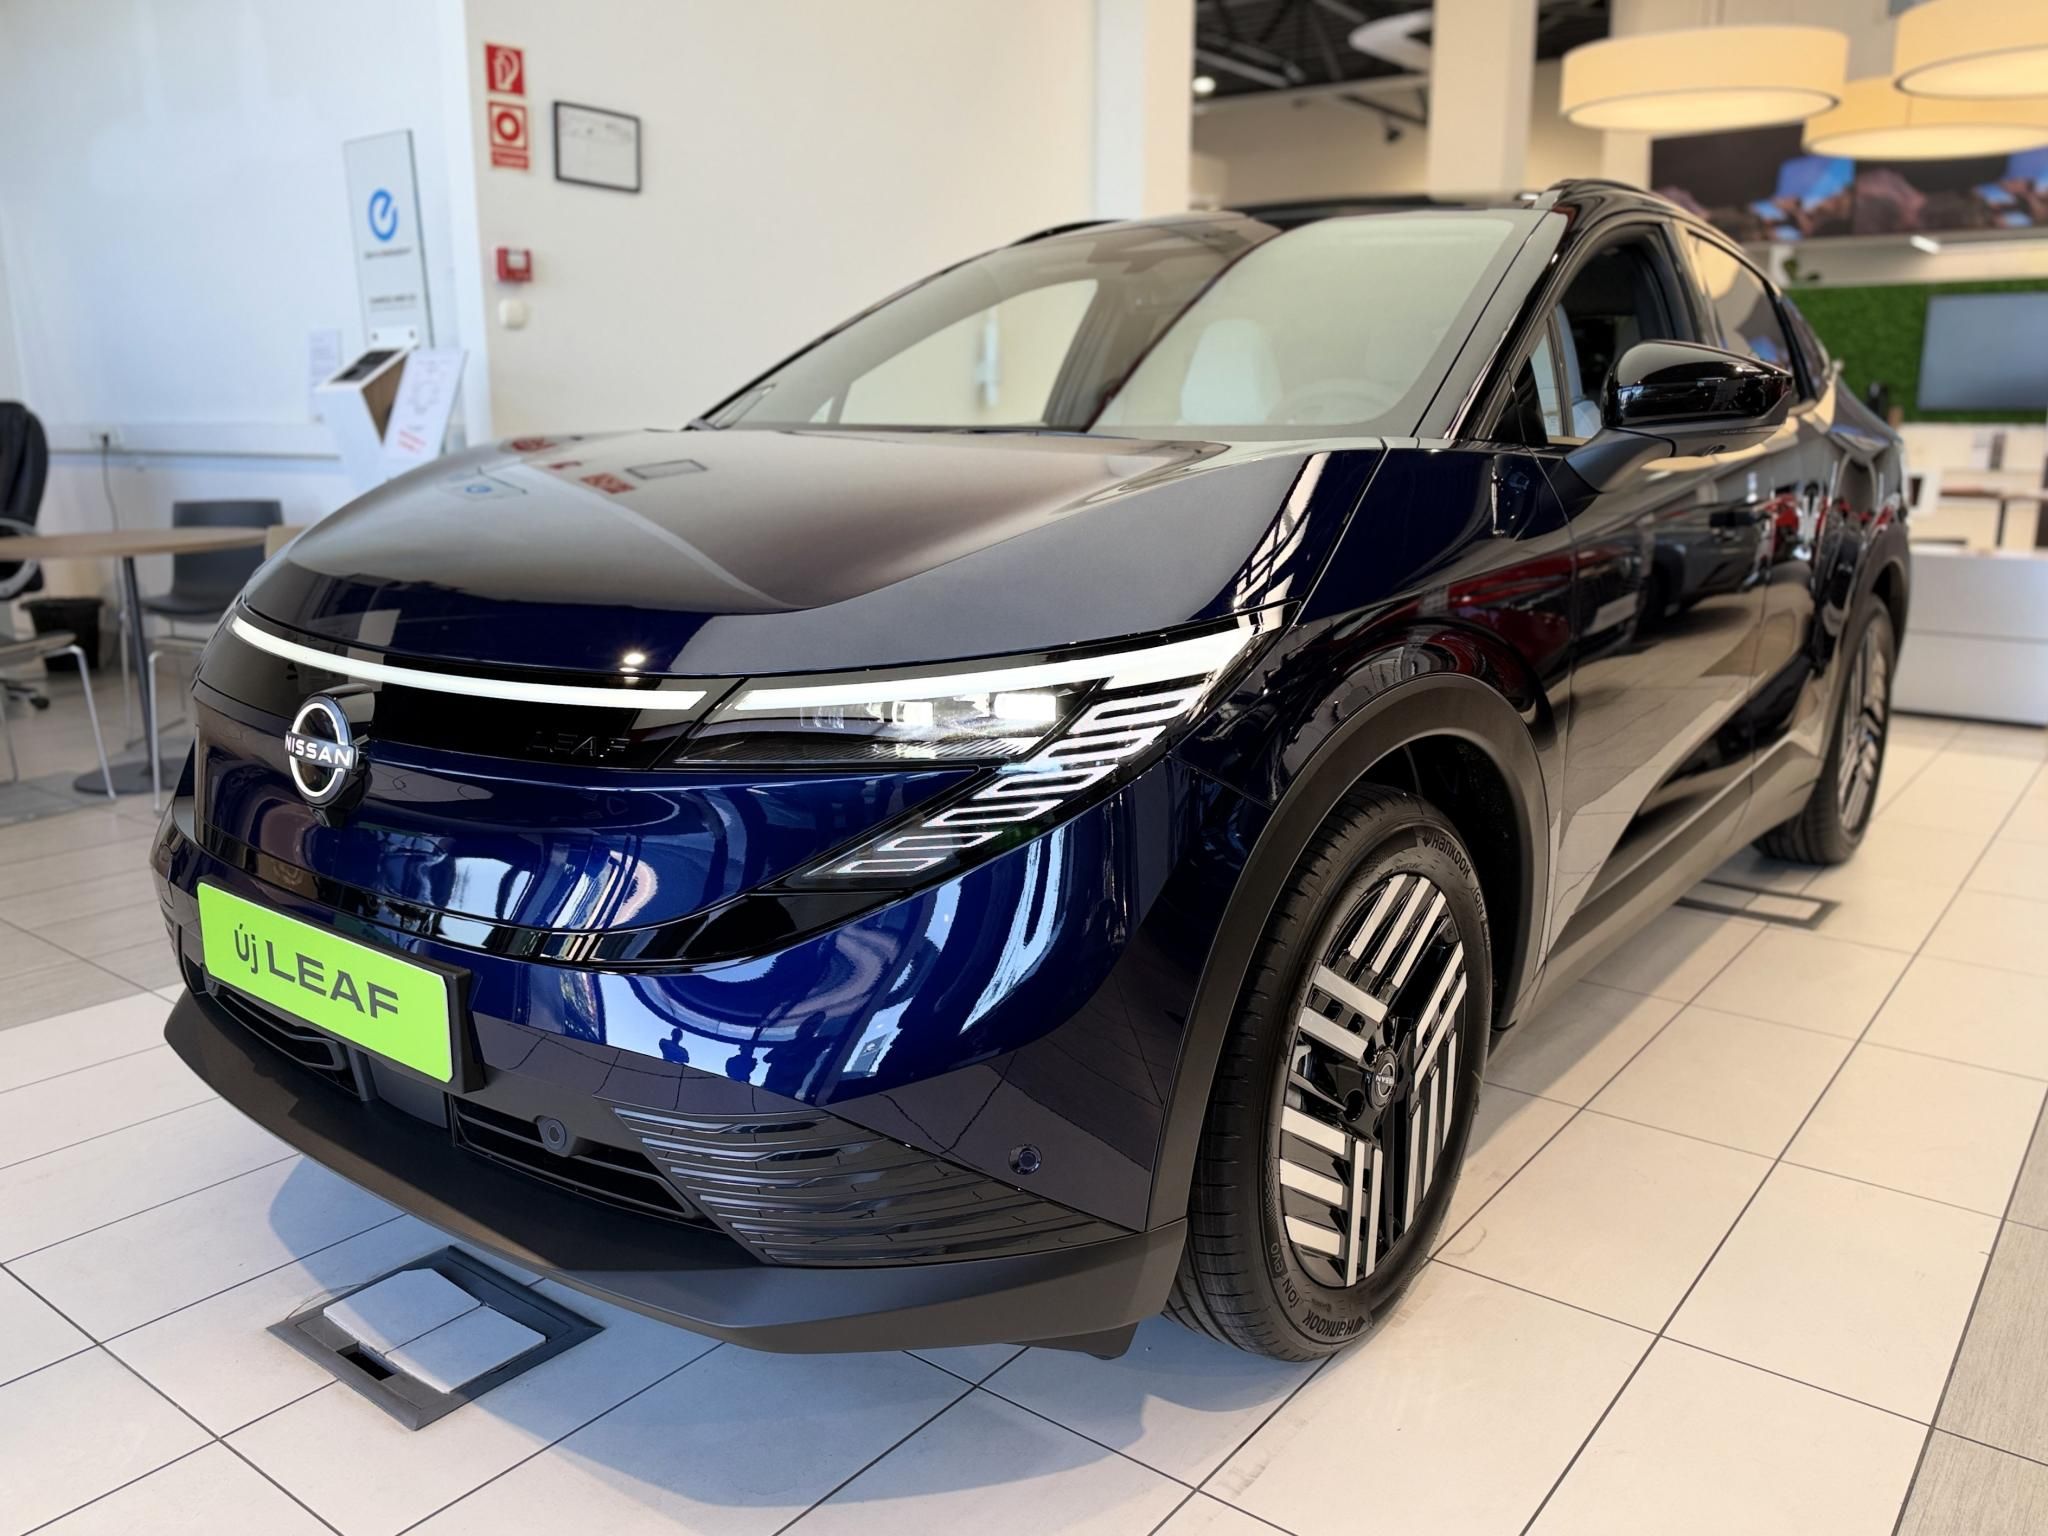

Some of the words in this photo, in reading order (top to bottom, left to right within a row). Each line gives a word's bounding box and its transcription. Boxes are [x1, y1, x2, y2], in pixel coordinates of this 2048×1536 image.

[285, 734, 351, 767] NISSAN
[234, 923, 258, 974] Új
[265, 940, 398, 1019] LEAF
